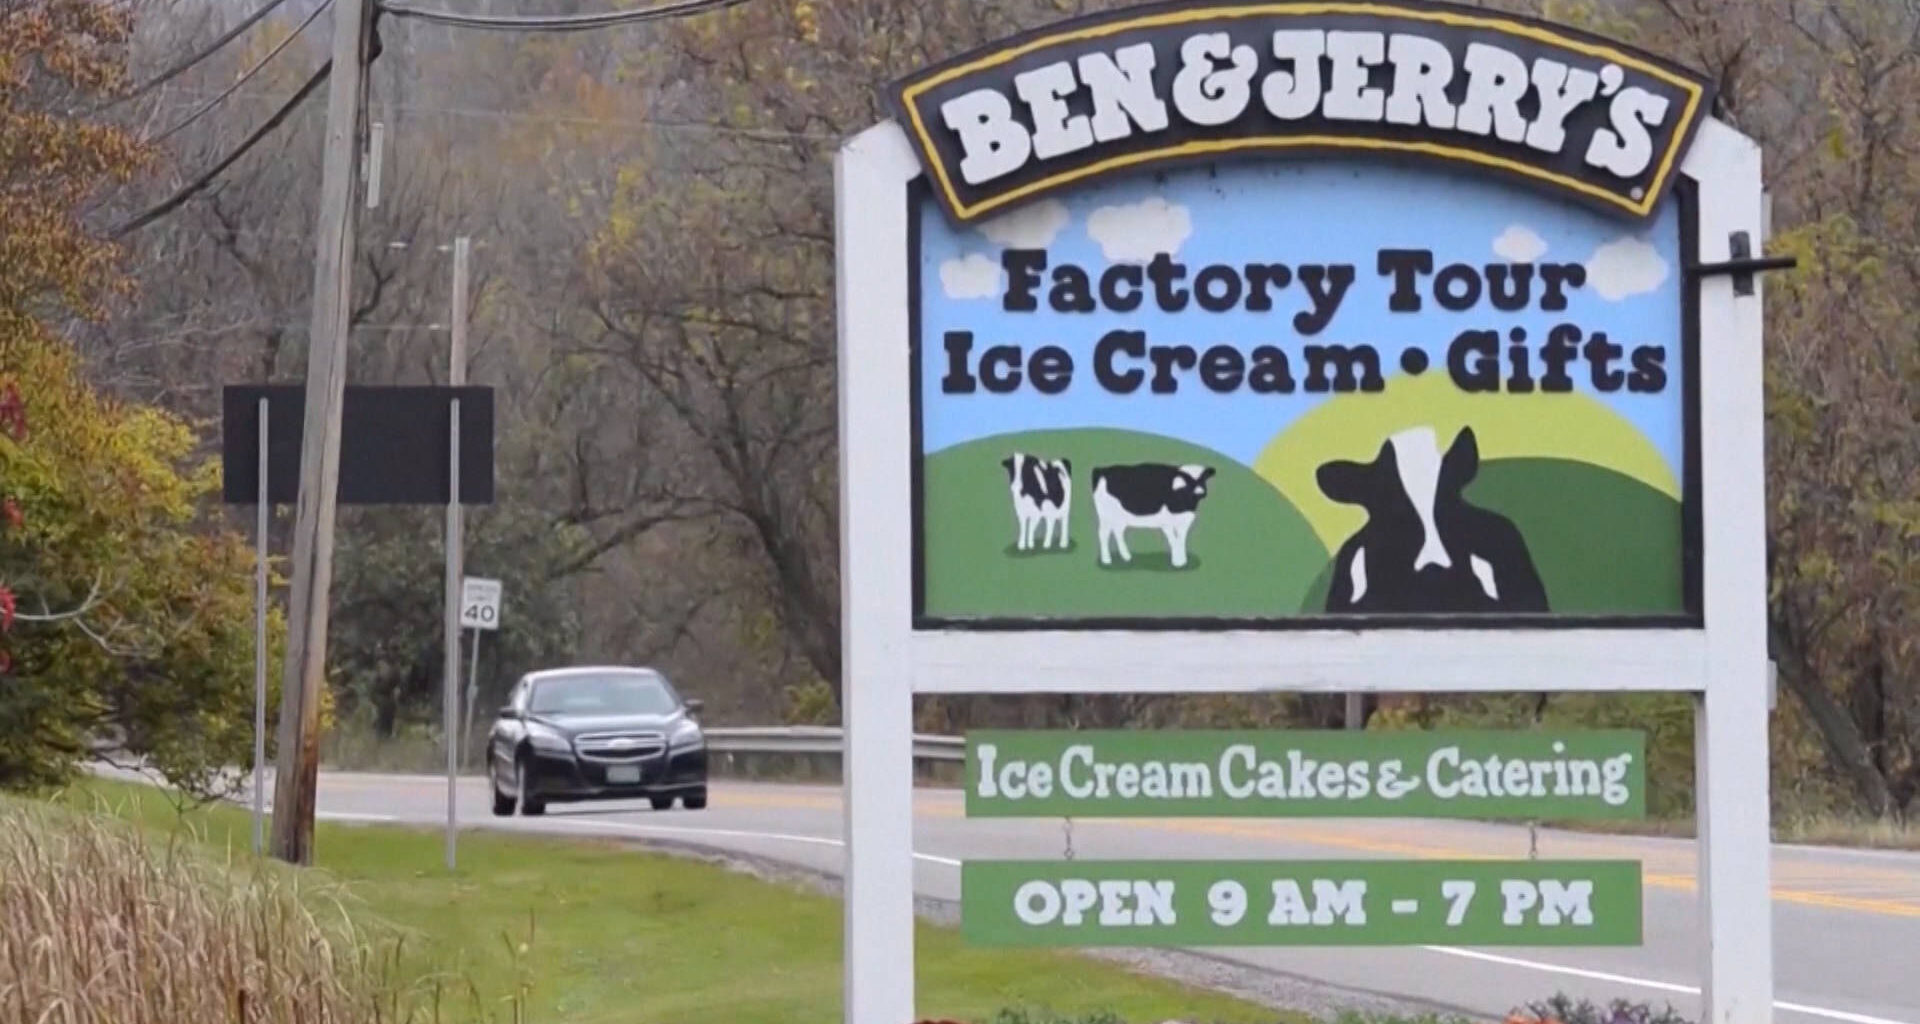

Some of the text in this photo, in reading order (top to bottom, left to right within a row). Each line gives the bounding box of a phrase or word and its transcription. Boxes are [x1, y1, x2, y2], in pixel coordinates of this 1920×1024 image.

[940, 28, 1670, 184] BEN & JERRY'S
[1001, 248, 1587, 336] Factory Tour
[942, 323, 1667, 395] Ice Cream Gifts
[464, 604, 495, 622] 40
[977, 741, 1633, 806] Ice Cream Cakes & Catering
[1013, 878, 1177, 927] OPEN
[1207, 879, 1248, 927] 9
[1267, 878, 1367, 926] AM
[1441, 879, 1476, 926] 7
[1500, 879, 1594, 926] PM
